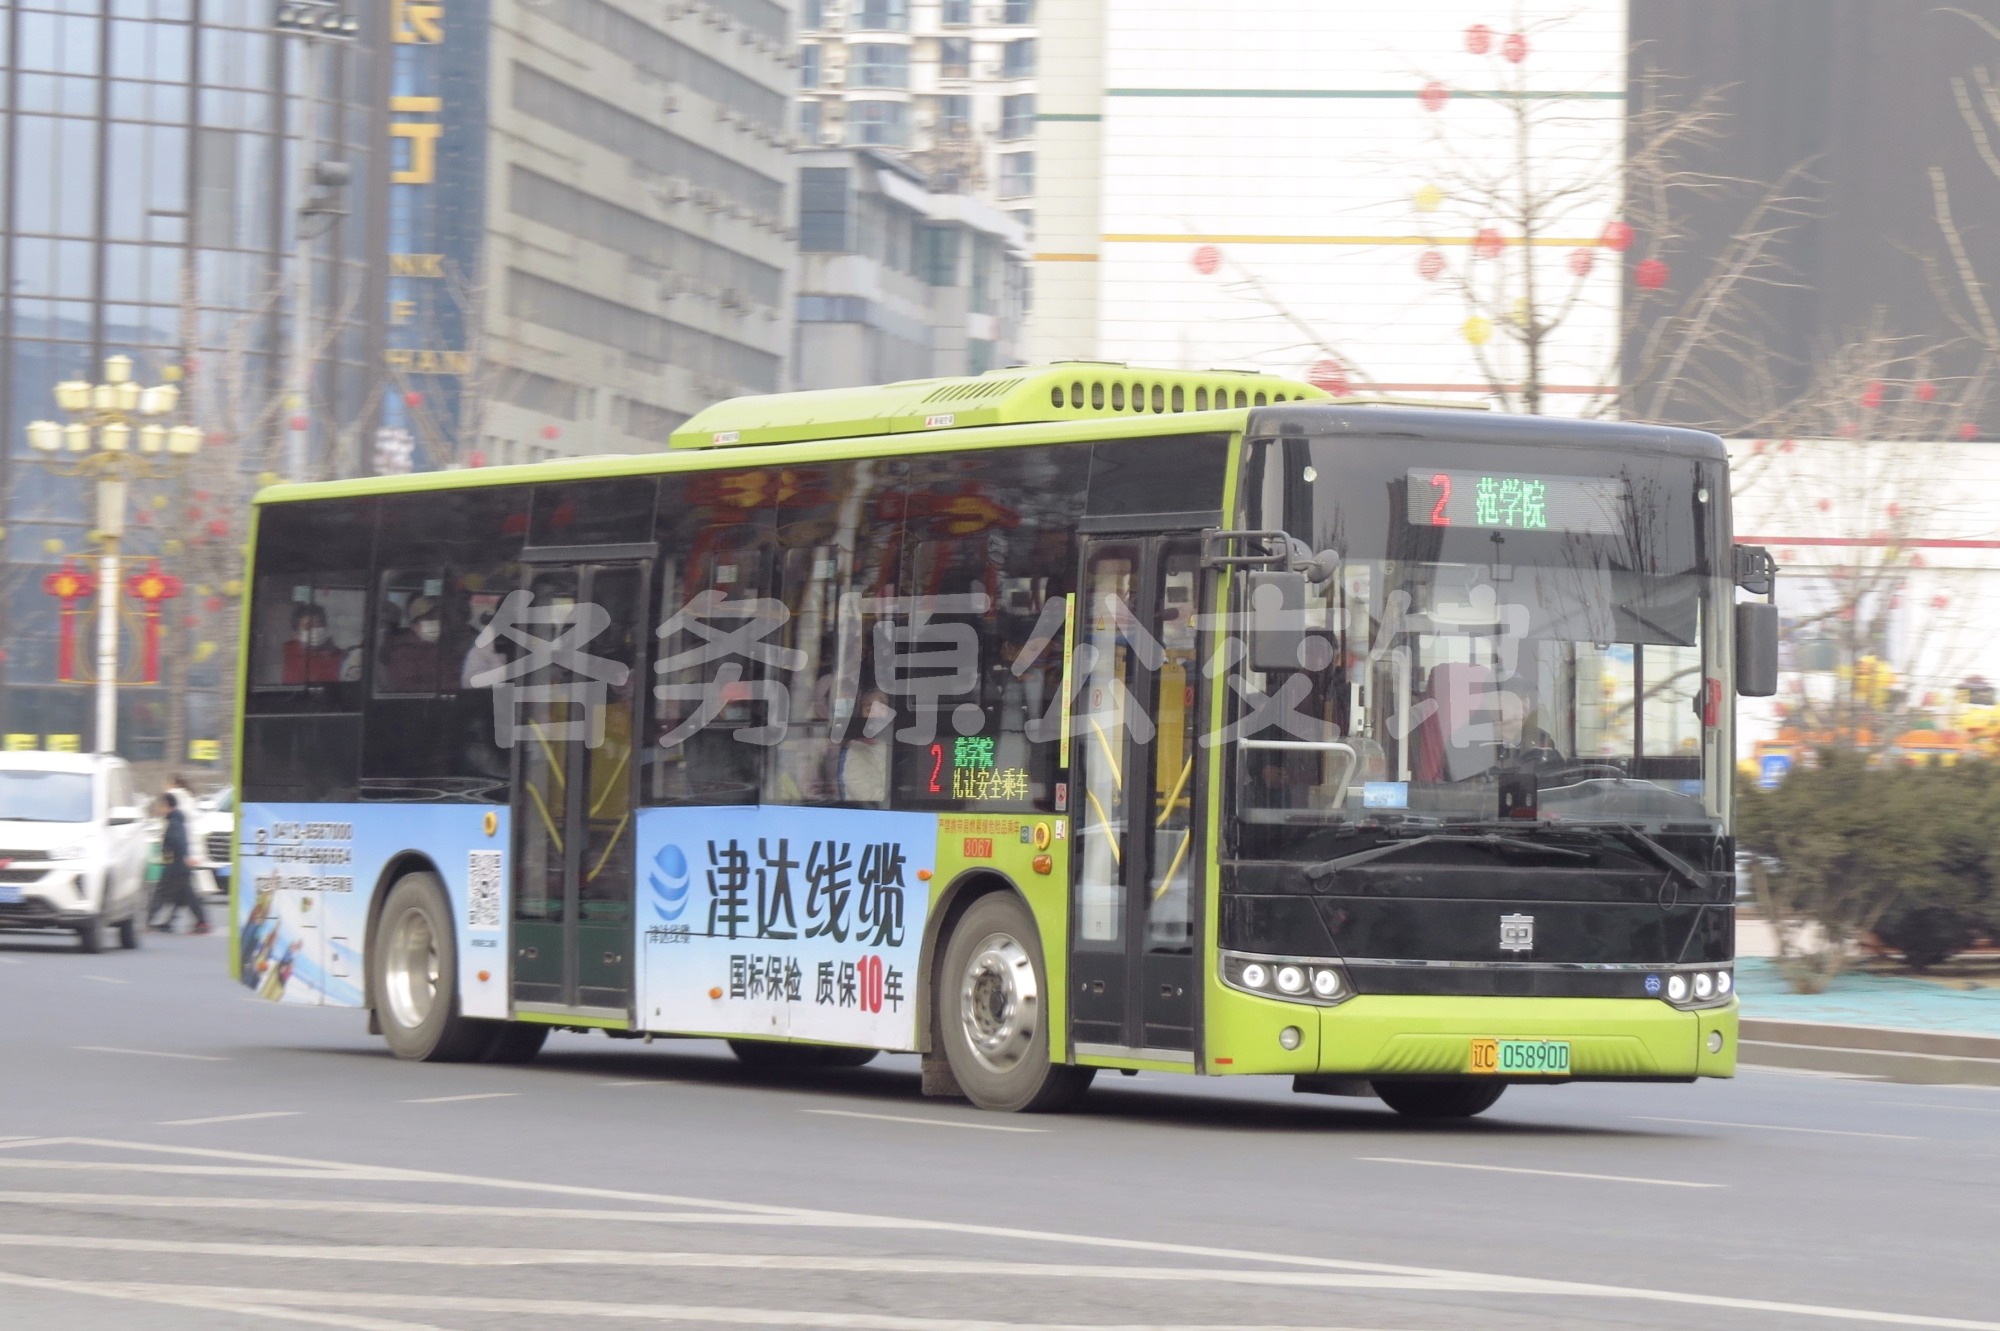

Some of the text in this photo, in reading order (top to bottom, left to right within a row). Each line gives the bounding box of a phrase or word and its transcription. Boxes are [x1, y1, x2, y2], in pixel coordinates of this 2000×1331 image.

[1431, 474, 1450, 526] 2
[929, 744, 942, 792] 2
[965, 839, 992, 857] 3067
[706, 837, 906, 947] 津达线缆
[815, 954, 904, 1013] 质保10年
